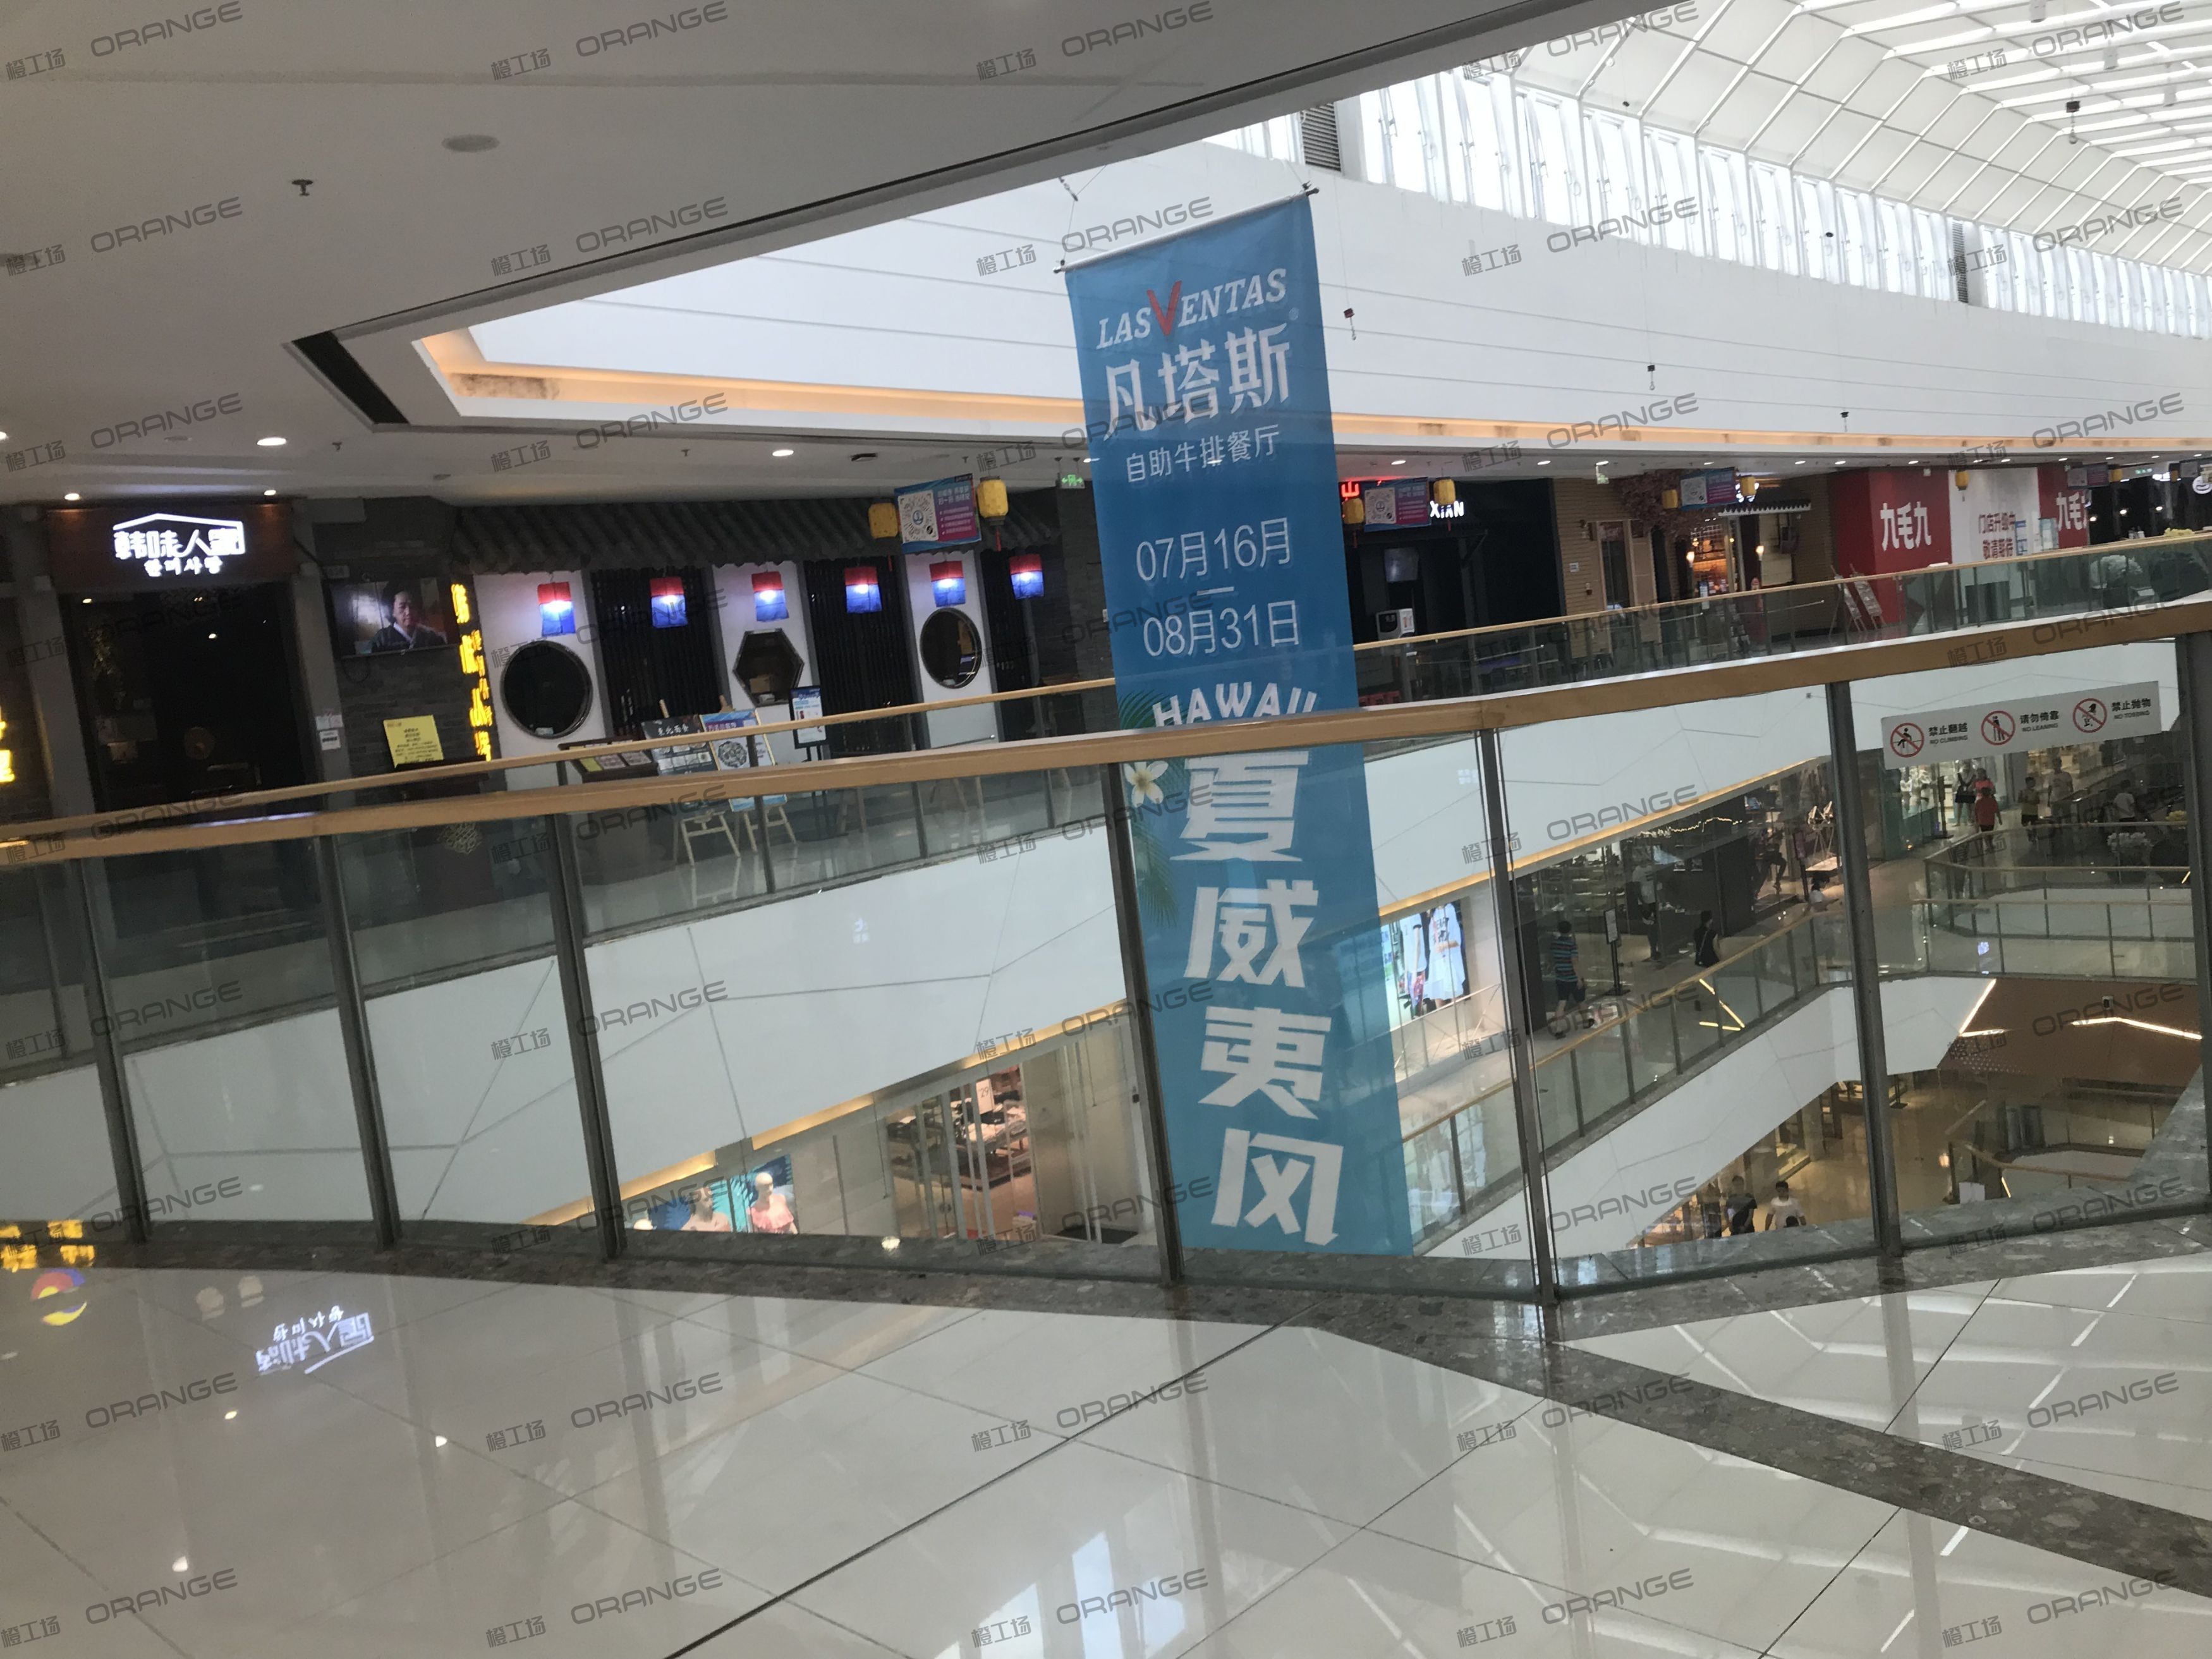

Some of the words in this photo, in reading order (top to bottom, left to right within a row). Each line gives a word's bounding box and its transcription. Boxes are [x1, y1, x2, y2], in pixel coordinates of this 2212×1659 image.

[1095, 267, 1287, 349] LASVENTAS
[1103, 322, 1290, 441] 凡塔斯
[1126, 424, 1280, 482] 自助牛排餐厅
[1136, 517, 1291, 581] 07月16月
[1880, 501, 1932, 552] 九毛九
[1143, 600, 1299, 657] 08月31日
[1152, 681, 1318, 727] HAWAII
[1169, 750, 1344, 1246] 夏威夷风
